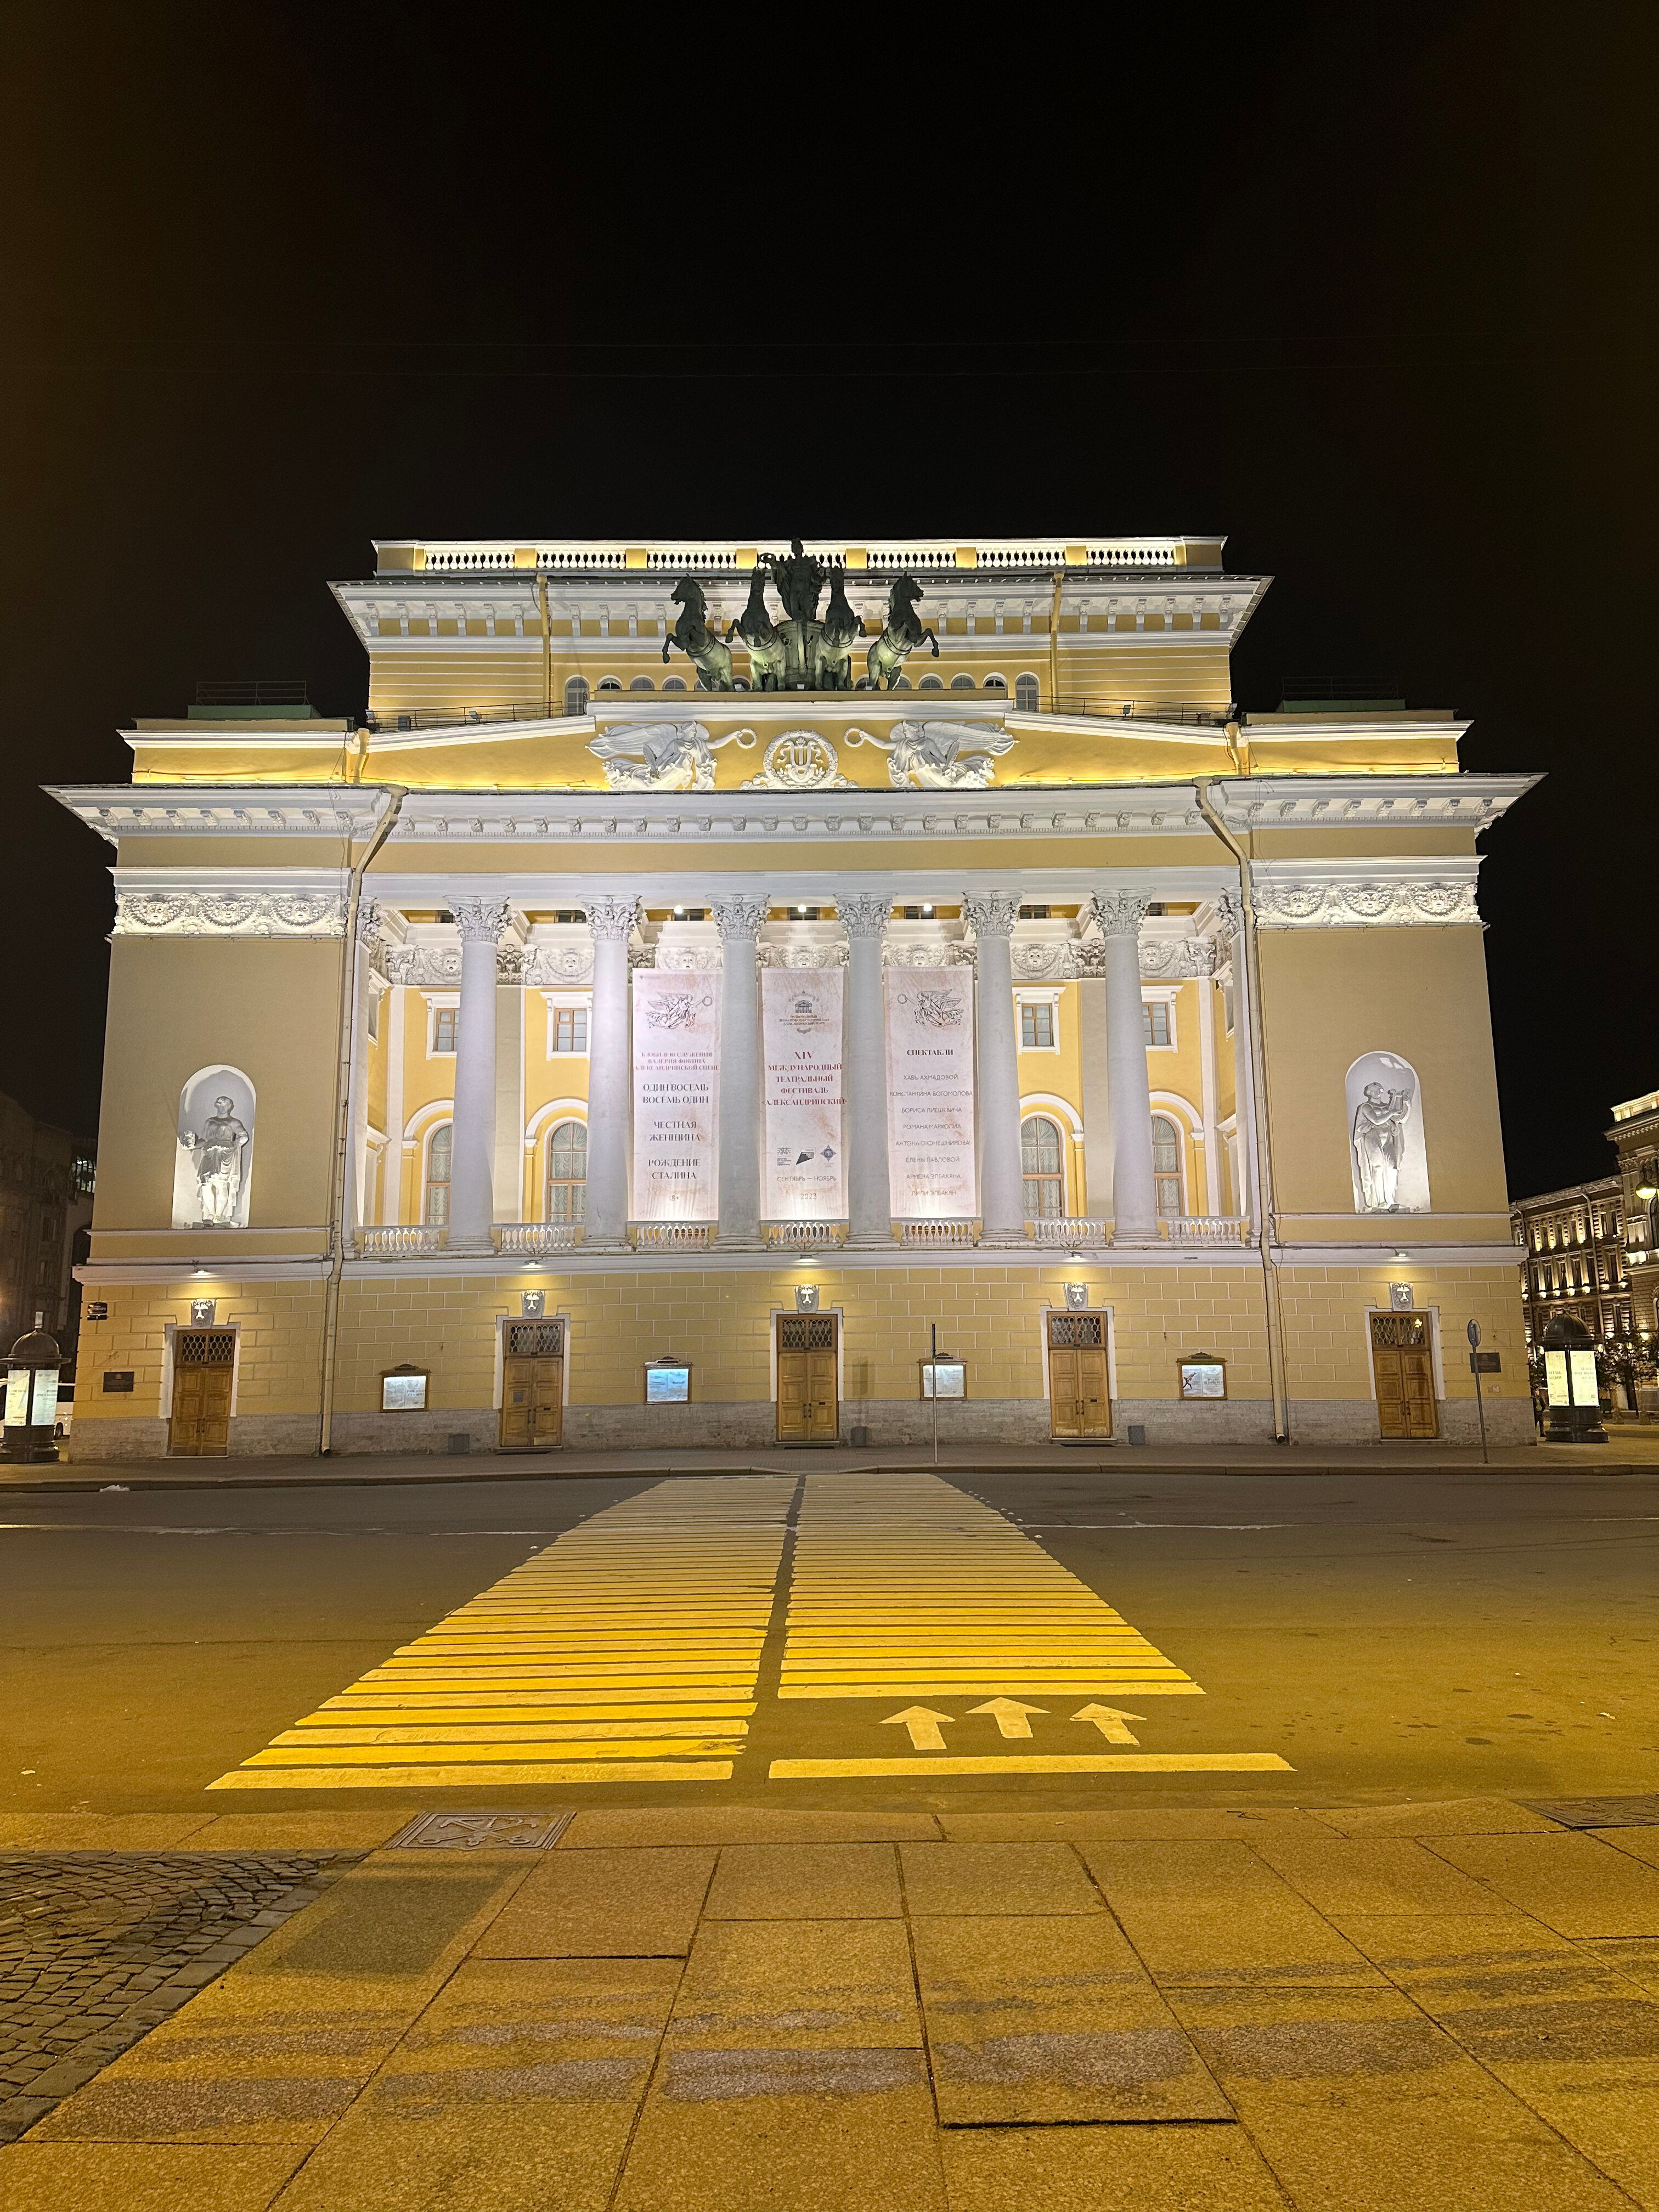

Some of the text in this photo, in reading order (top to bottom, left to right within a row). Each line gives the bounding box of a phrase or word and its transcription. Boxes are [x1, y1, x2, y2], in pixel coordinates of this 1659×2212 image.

[768, 1063, 842, 1071] МЕЖДУНАРОДНЫЙ
[682, 1096, 708, 1104] ОДИН
[648, 1159, 701, 1167] РОЖДЕНИЕ
